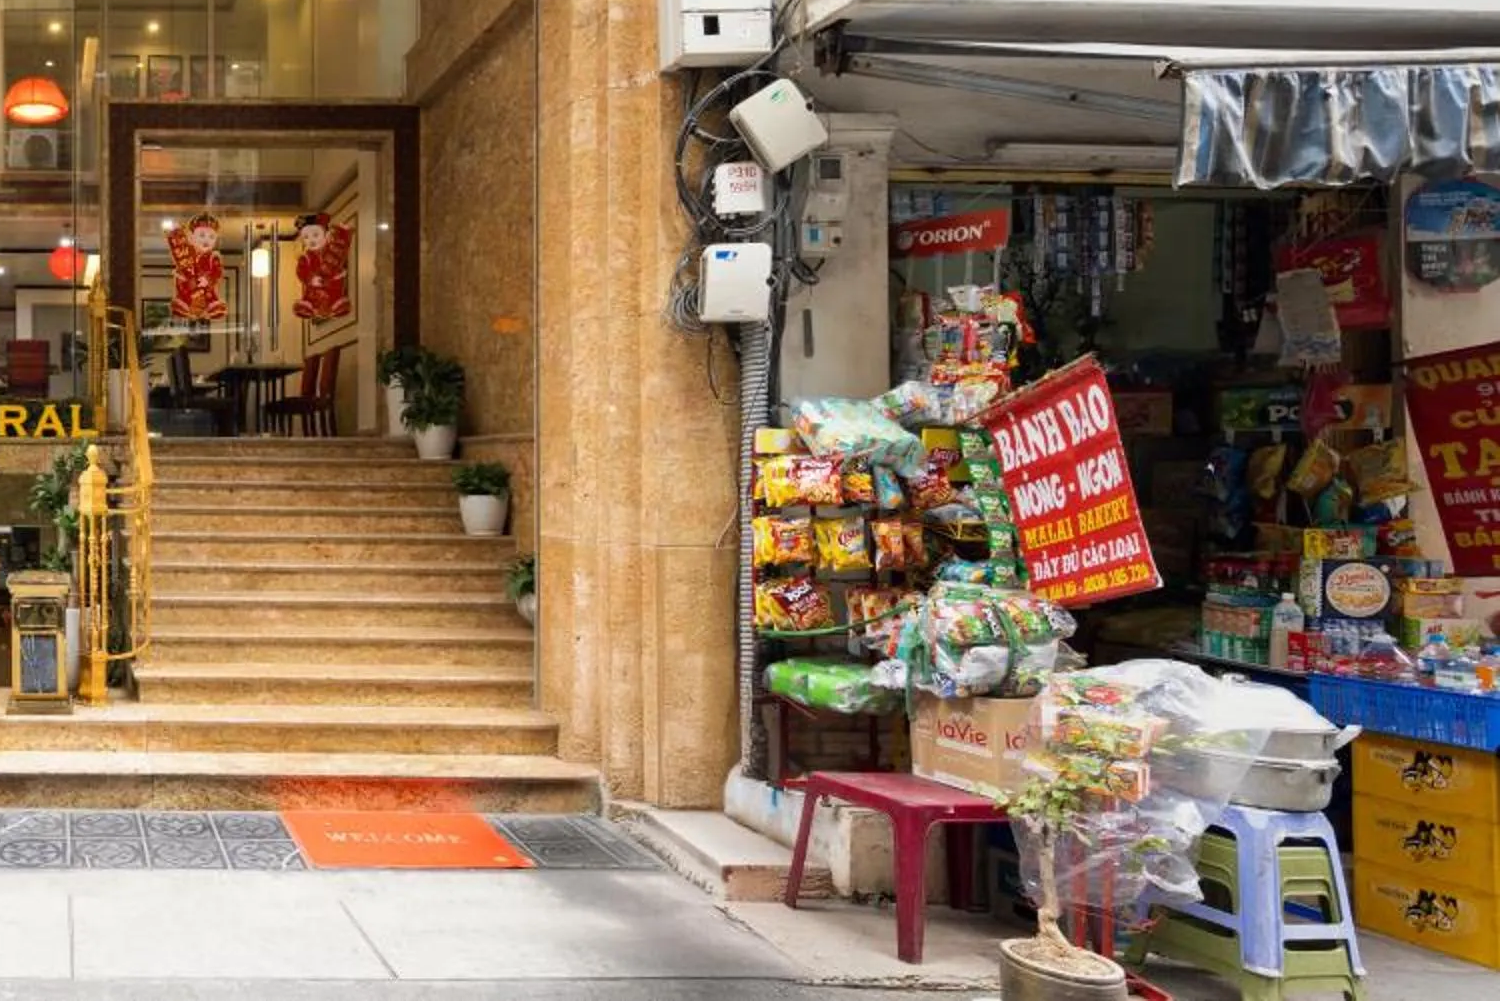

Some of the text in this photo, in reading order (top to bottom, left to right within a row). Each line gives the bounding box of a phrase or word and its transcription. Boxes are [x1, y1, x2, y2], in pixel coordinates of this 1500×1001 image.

[1057, 383, 1111, 446] BAO
[1075, 448, 1124, 501] NGON
[936, 717, 988, 748] laVie
[323, 830, 470, 845] WELCOME
